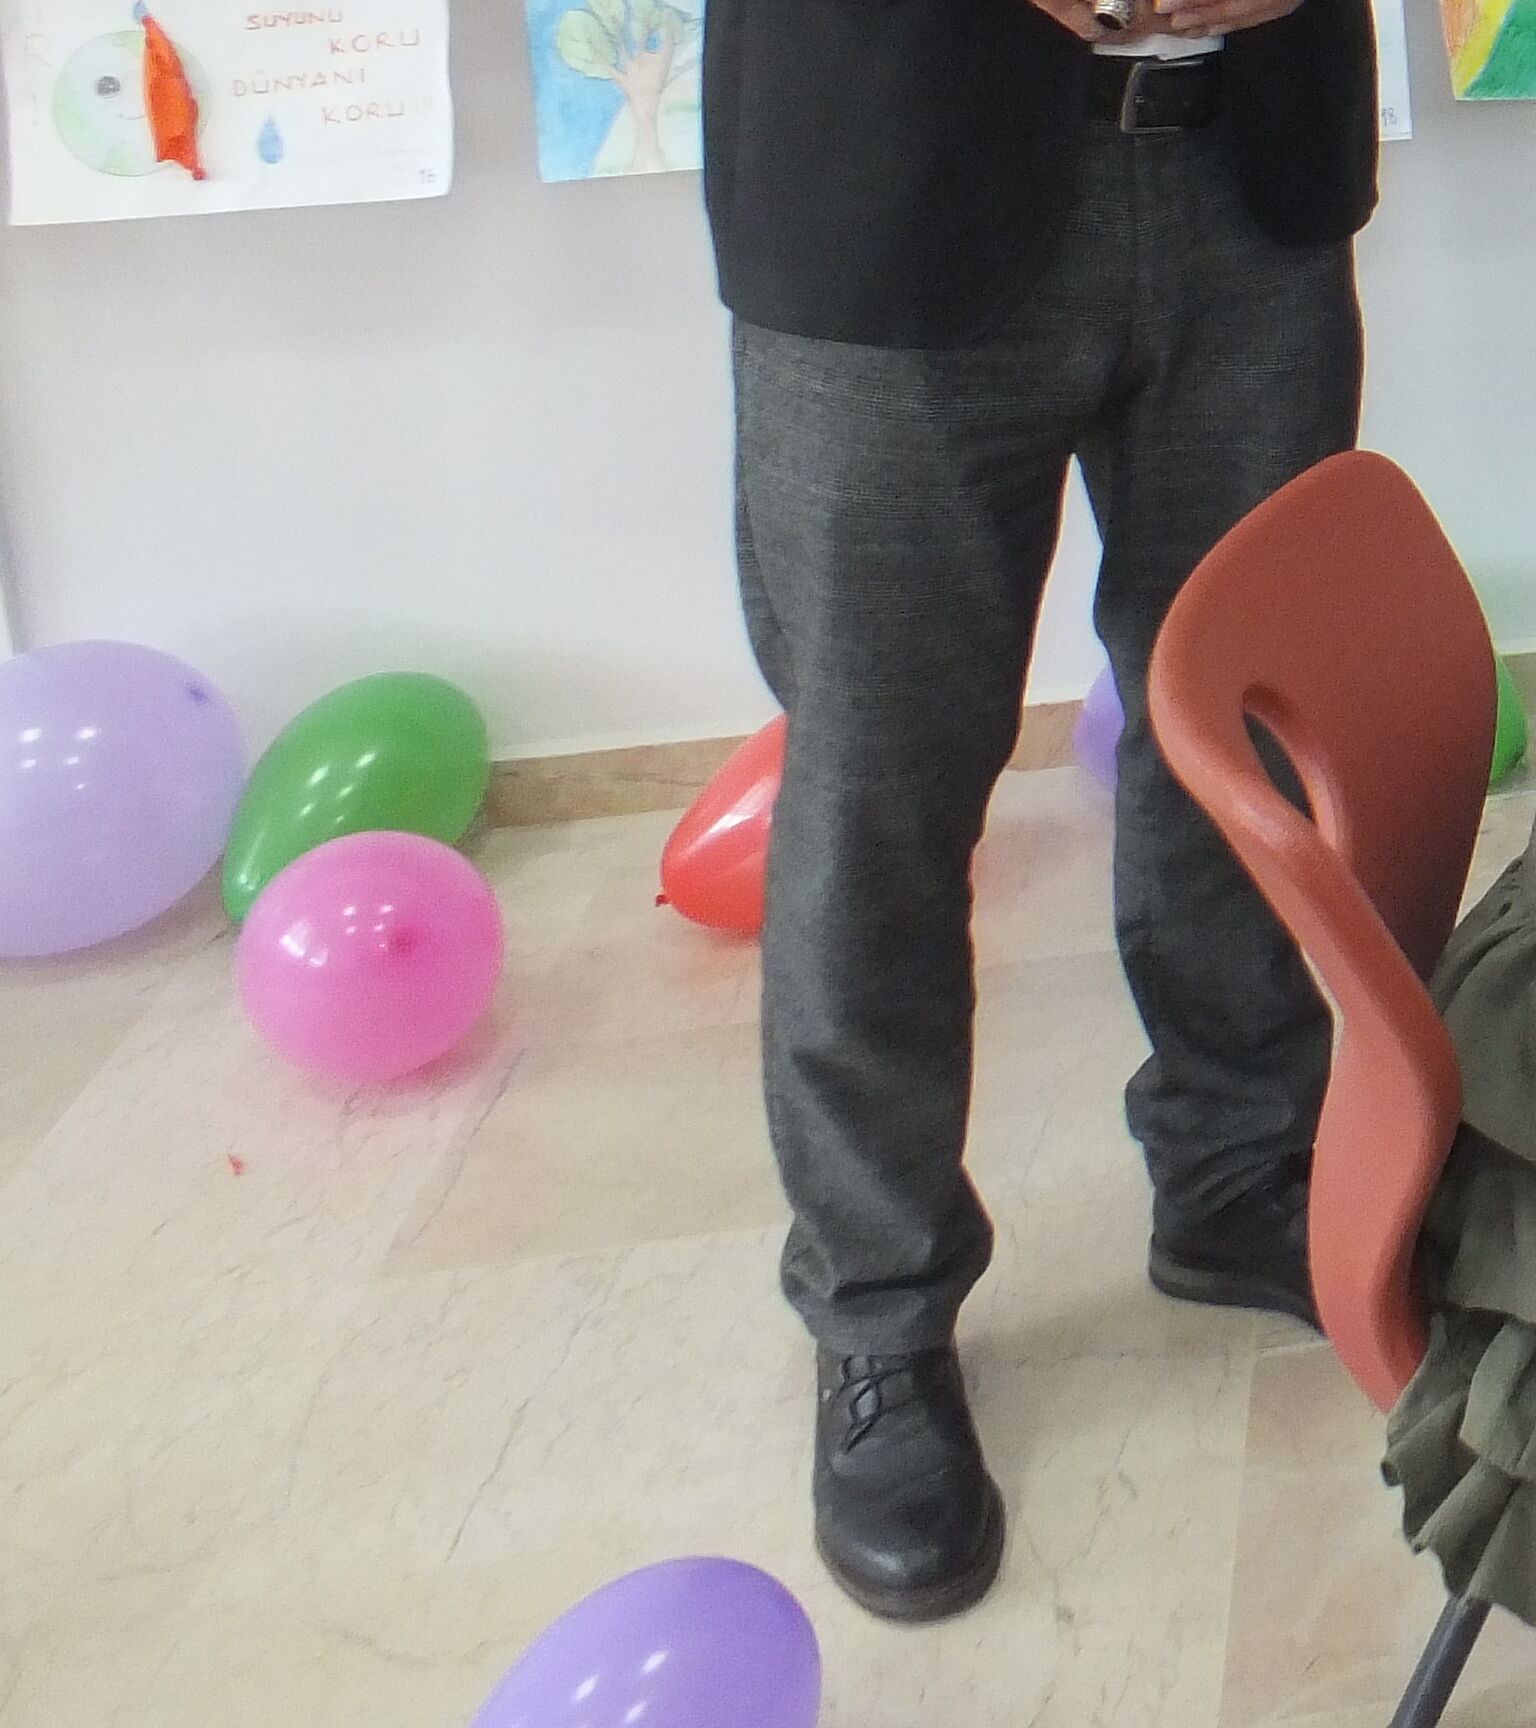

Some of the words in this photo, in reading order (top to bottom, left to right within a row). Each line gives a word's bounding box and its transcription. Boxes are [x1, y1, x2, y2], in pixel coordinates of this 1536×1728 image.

[245, 9, 343, 30] SUYUNU
[329, 28, 419, 55] KORU
[233, 66, 365, 97] DÜNYANI
[322, 100, 404, 124] KORU
